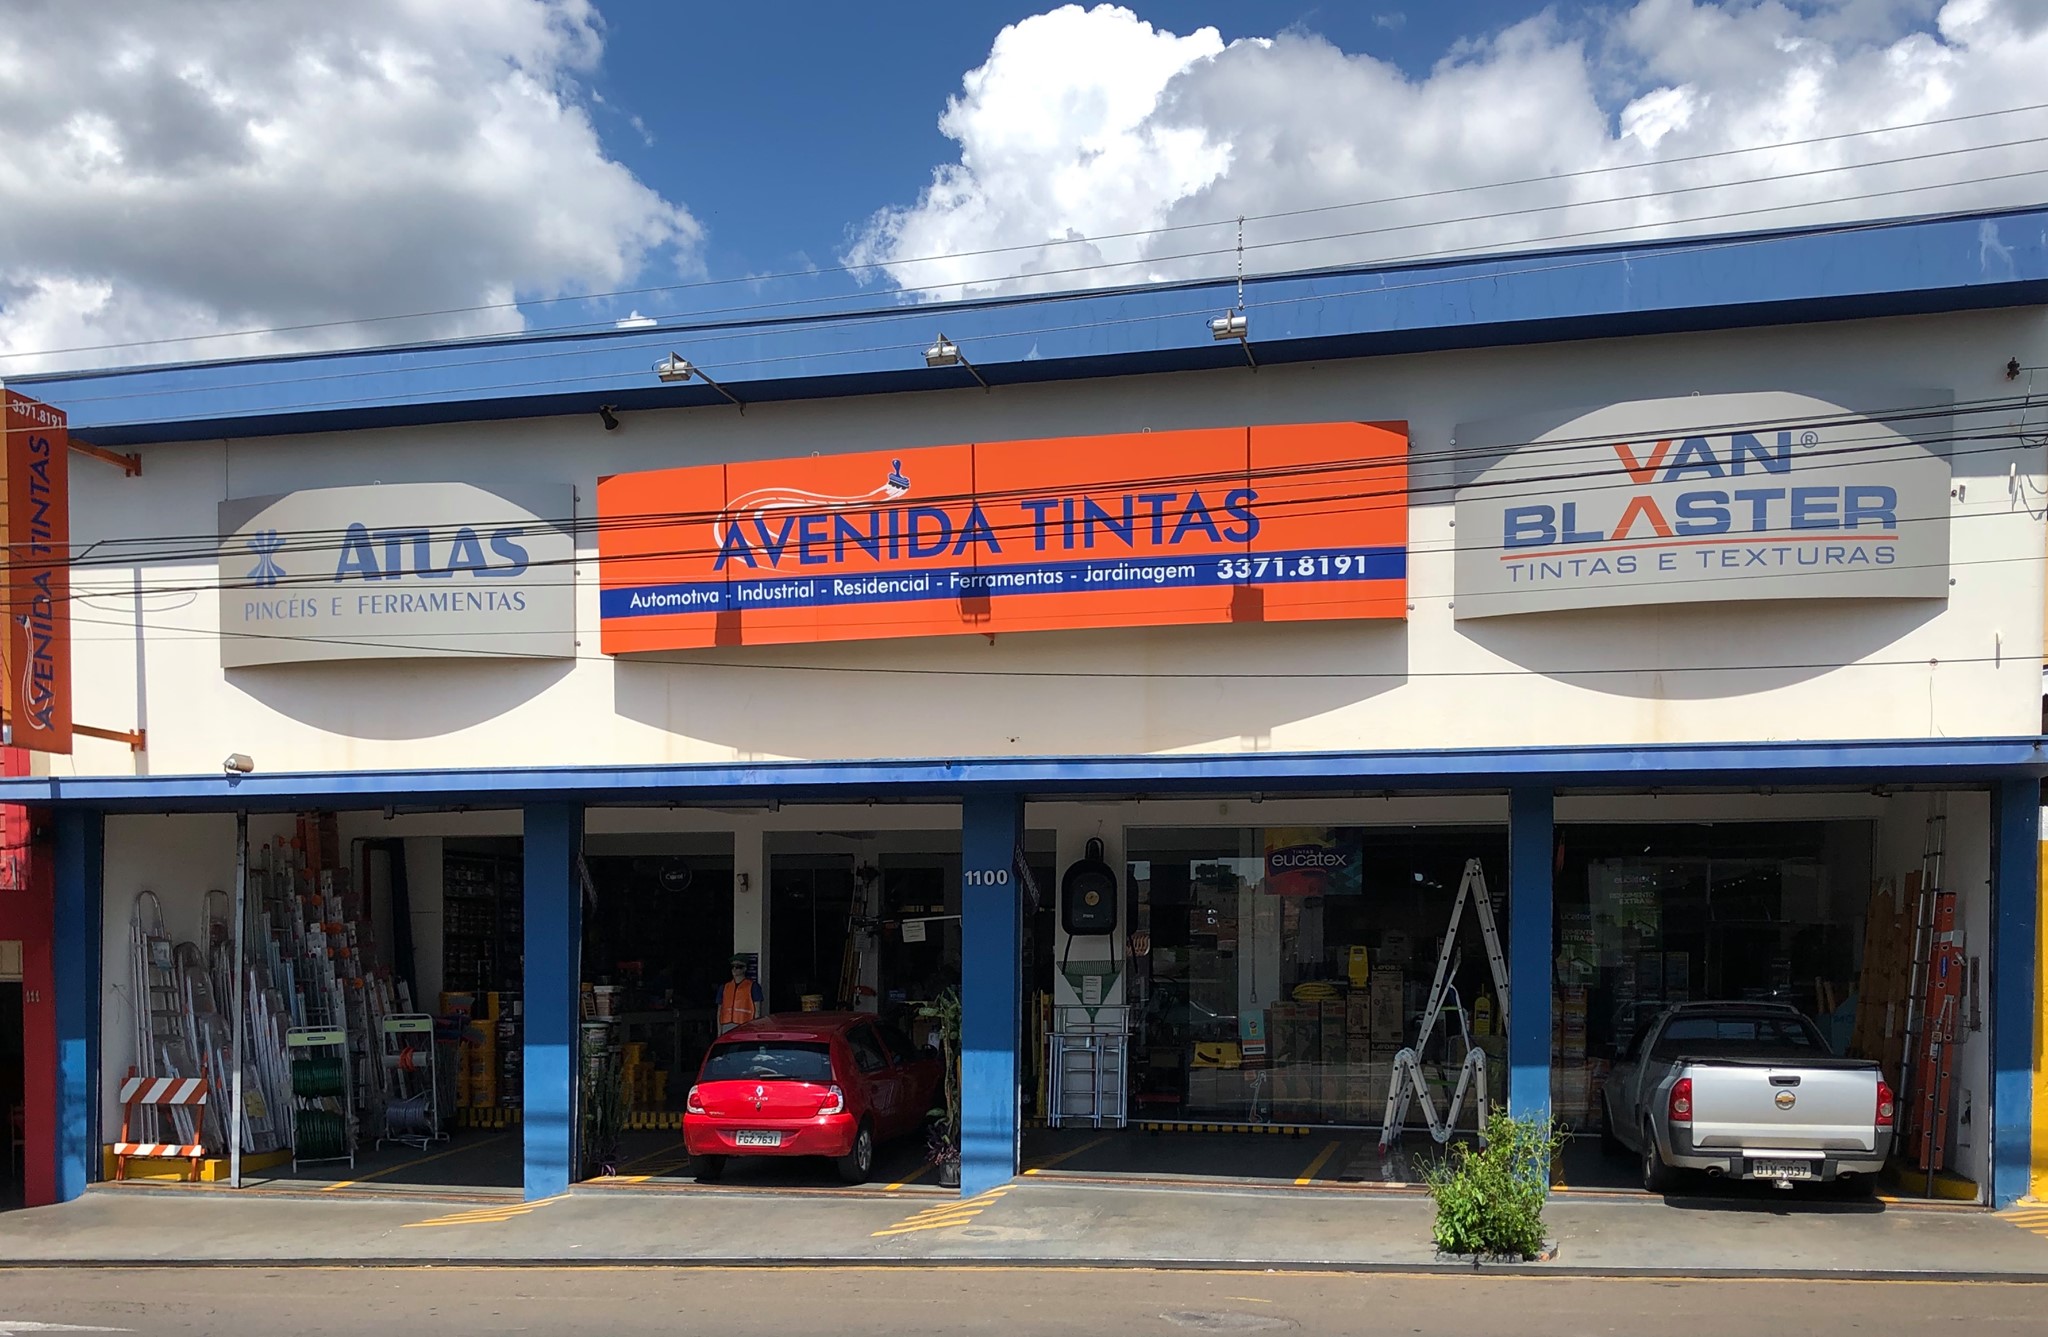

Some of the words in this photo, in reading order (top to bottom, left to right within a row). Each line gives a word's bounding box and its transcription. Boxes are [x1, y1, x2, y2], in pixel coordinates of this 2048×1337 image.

[12, 399, 62, 429] 3371.8191
[1613, 431, 1791, 484] VAN
[29, 435, 51, 555] TINTAS
[1503, 485, 1897, 550] BLASTER
[334, 521, 530, 584] ATLAS
[713, 502, 1002, 571] AVENIDA
[1021, 488, 1261, 550] TINTAS
[630, 589, 719, 609] Automotiva
[737, 580, 814, 602] Industrial
[834, 573, 930, 597] Residencial
[950, 569, 1063, 590] Ferramentas
[1083, 563, 1195, 585] Jardinagem
[1216, 555, 1366, 580] 3371.8191
[1506, 554, 1637, 582] TINTAS
[1659, 552, 1677, 571] E
[1695, 545, 1895, 569] TEXTURAS
[245, 592, 317, 621] PINCÉIS
[332, 598, 342, 616] E
[358, 591, 526, 615] FERRAMENTAS
[32, 571, 54, 732] AVENIDA
[965, 869, 1008, 886] 1100
[1271, 851, 1347, 867] eucatex
